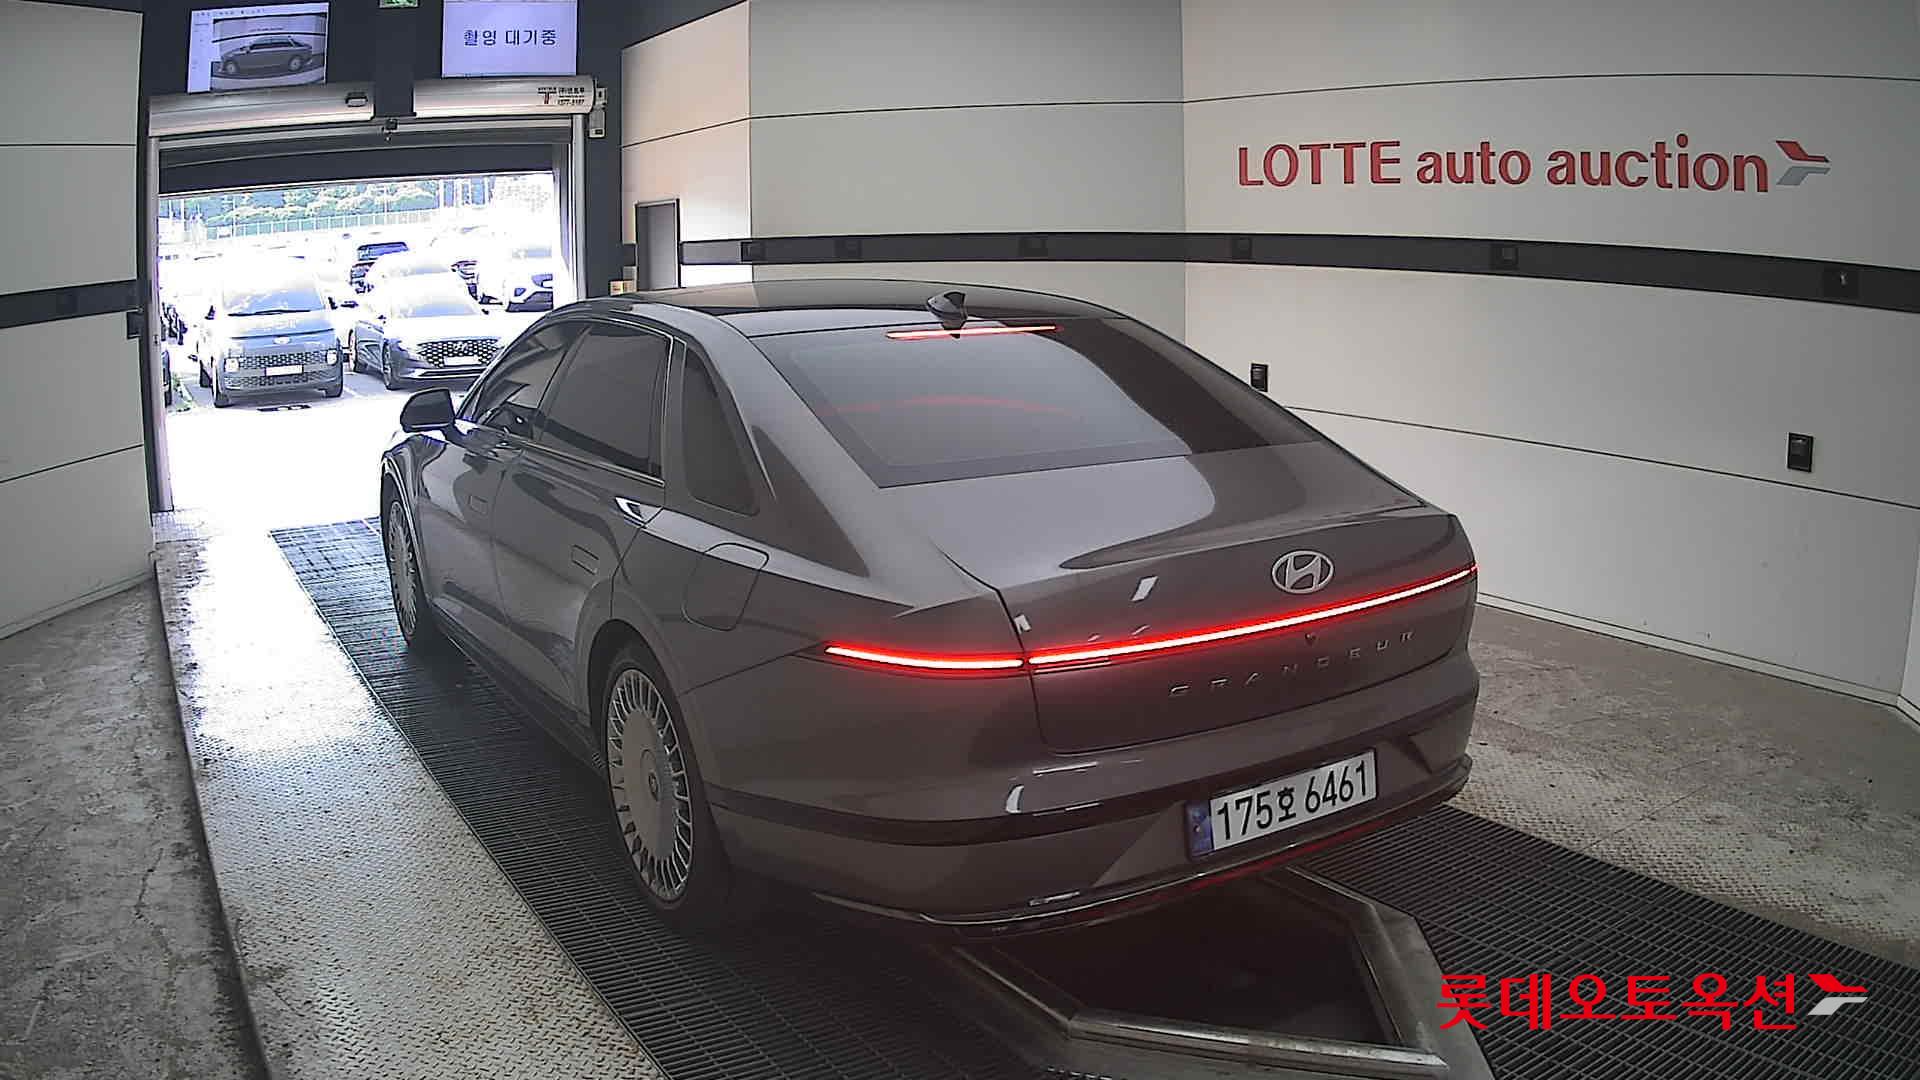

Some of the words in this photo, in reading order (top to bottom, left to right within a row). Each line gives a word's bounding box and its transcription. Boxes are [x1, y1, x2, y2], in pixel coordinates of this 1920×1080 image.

[505, 29, 557, 46] 대기중
[1238, 141, 1401, 187] LOTTE
[1416, 141, 1531, 185] auto
[1546, 134, 1769, 193] auction
[1170, 631, 1413, 696] GRANDEUR
[1304, 759, 1367, 814] 6461
